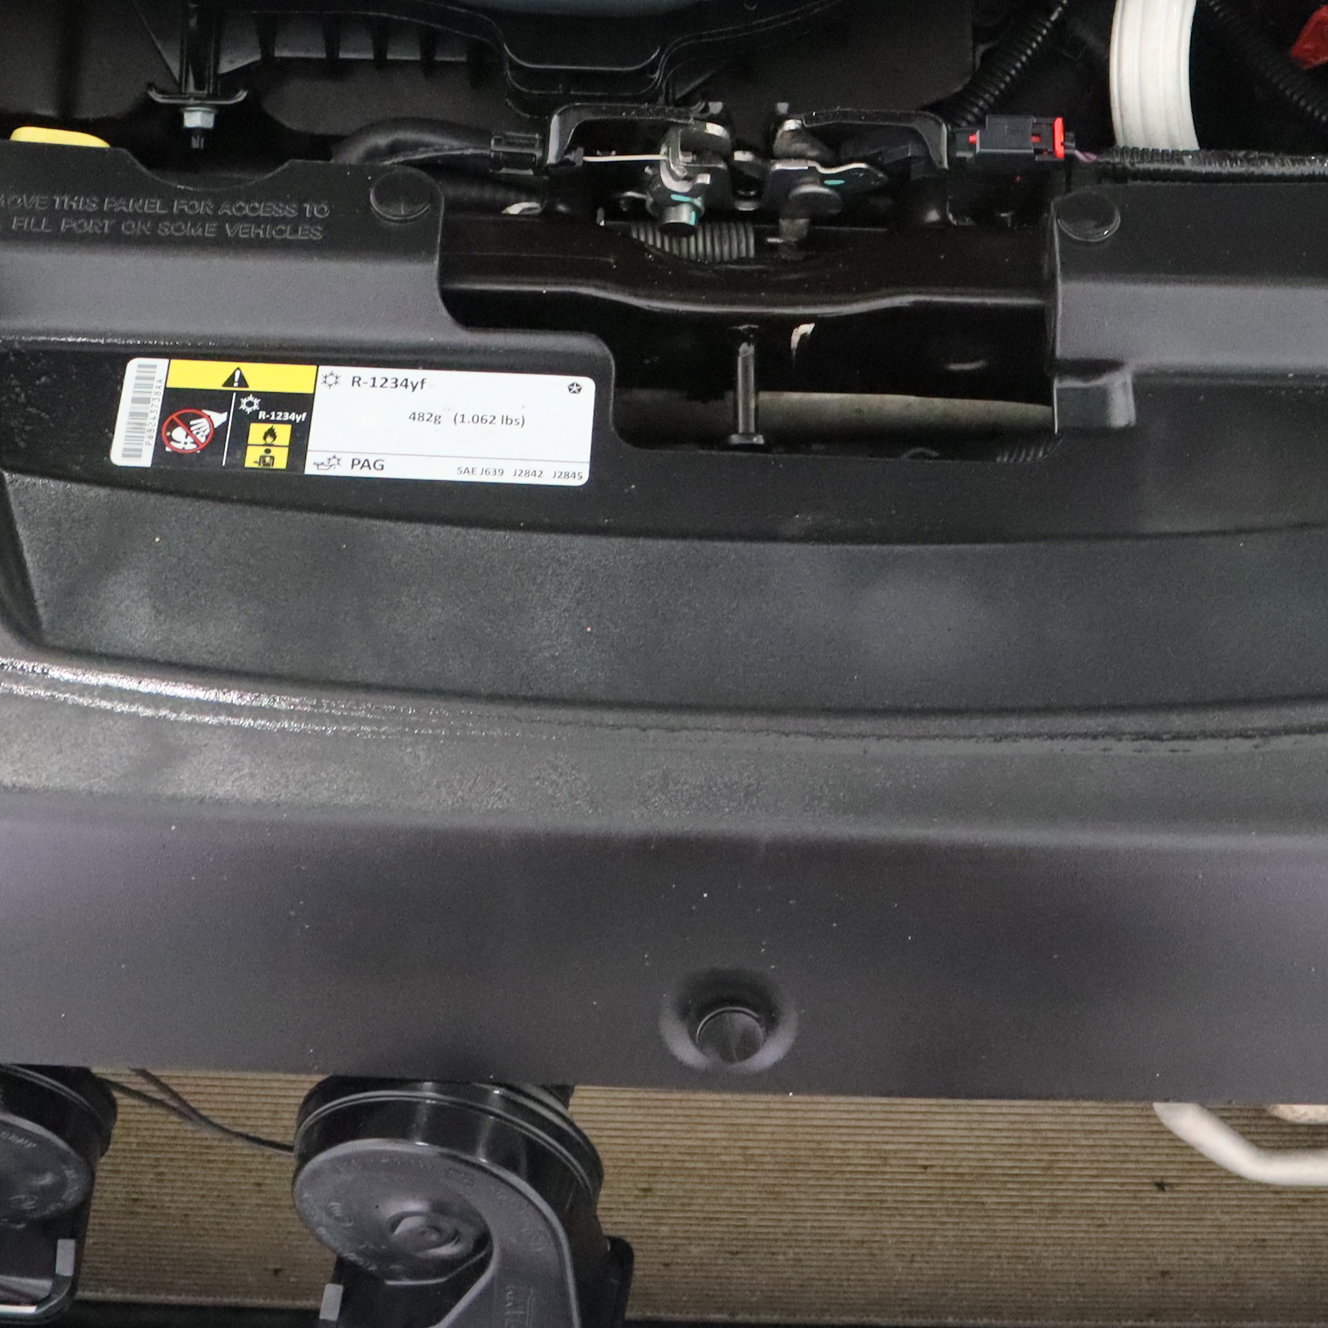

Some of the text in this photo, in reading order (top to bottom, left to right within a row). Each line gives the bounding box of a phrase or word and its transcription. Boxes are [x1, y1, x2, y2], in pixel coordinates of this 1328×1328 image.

[53, 196, 97, 212] THIS
[103, 198, 168, 214] PANEL
[173, 200, 215, 215] FOR
[218, 201, 298, 217] ACCESS
[303, 203, 331, 219] TO
[11, 216, 53, 233] FILL
[60, 218, 113, 234] PORT
[121, 220, 153, 235] ON
[157, 222, 217, 237] SOME
[225, 222, 324, 240] VEHICLES
[351, 375, 427, 392] R-1234yf
[258, 410, 308, 423] R-1234yf
[408, 410, 526, 428] 482g (1.062 lbs)
[350, 457, 584, 480] PAG SAE J639 J2842 J2845
